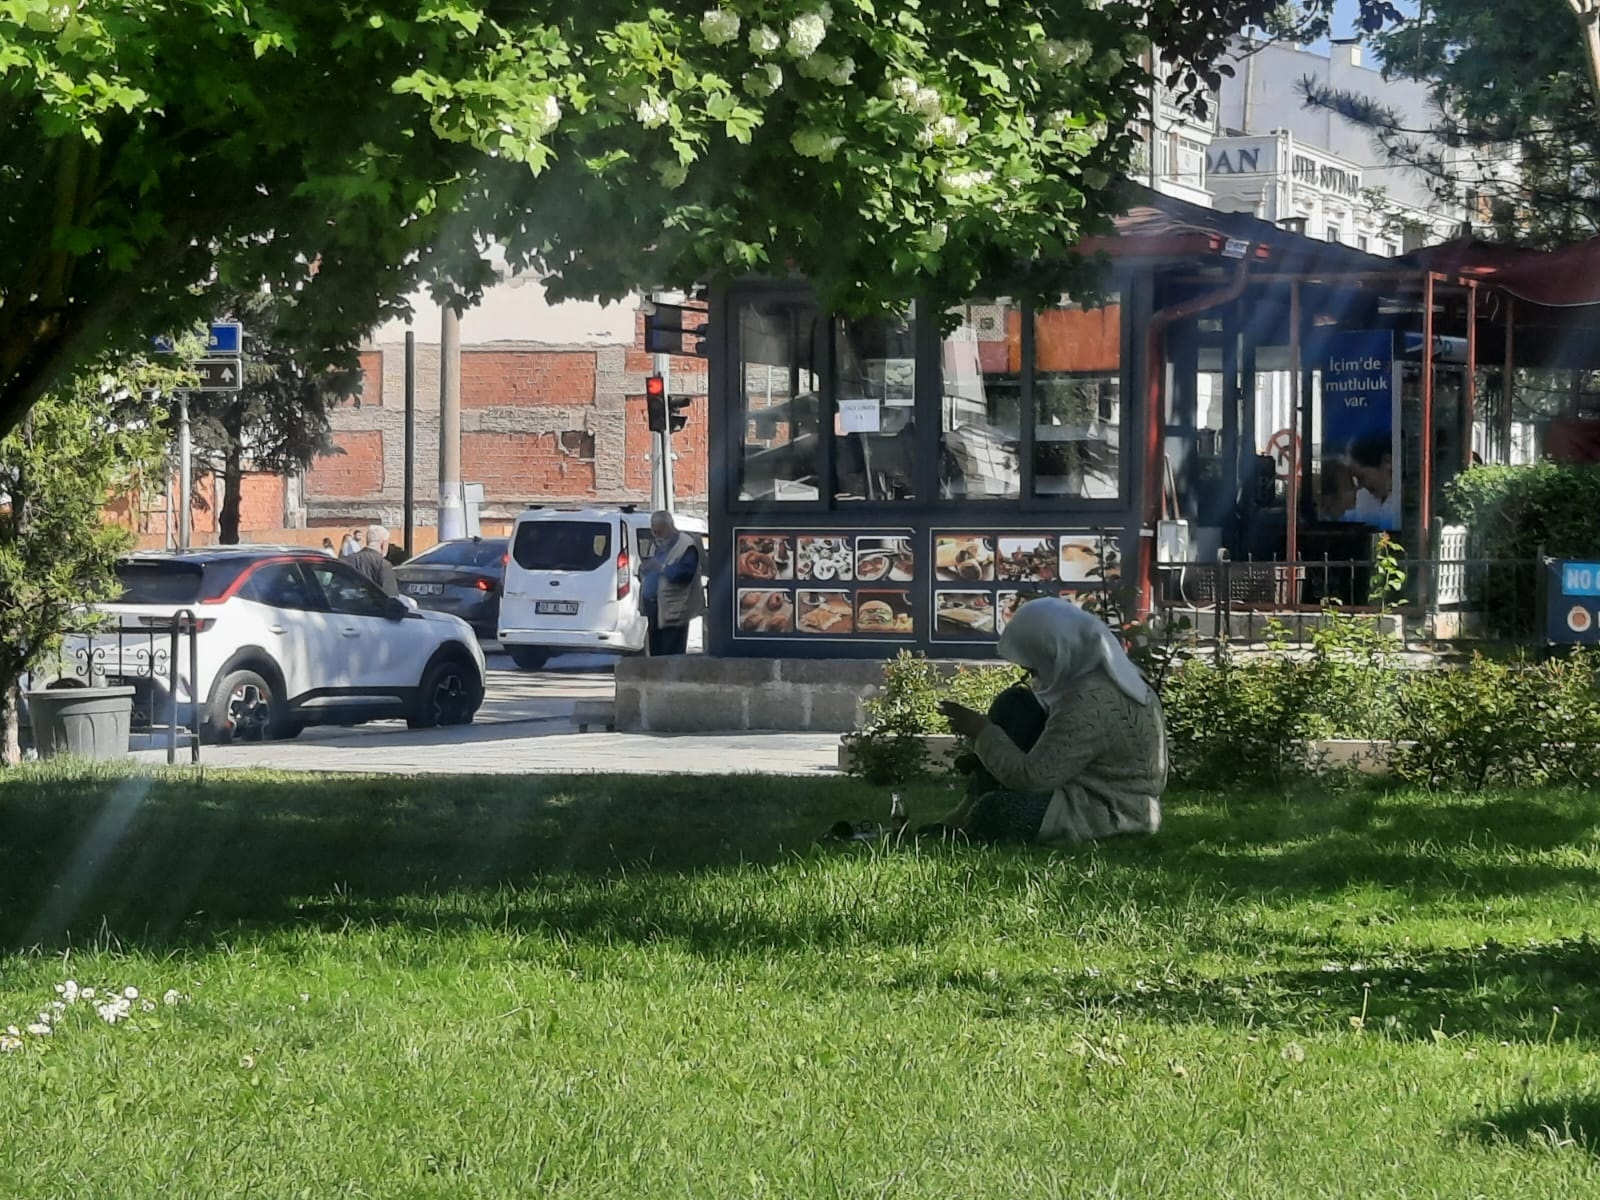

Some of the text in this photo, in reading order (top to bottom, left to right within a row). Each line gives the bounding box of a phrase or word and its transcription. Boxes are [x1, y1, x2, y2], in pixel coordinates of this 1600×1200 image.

[1325, 376, 1388, 391] mutluluk
[1344, 396, 1368, 408] var.
[1567, 569, 1592, 590] NO
